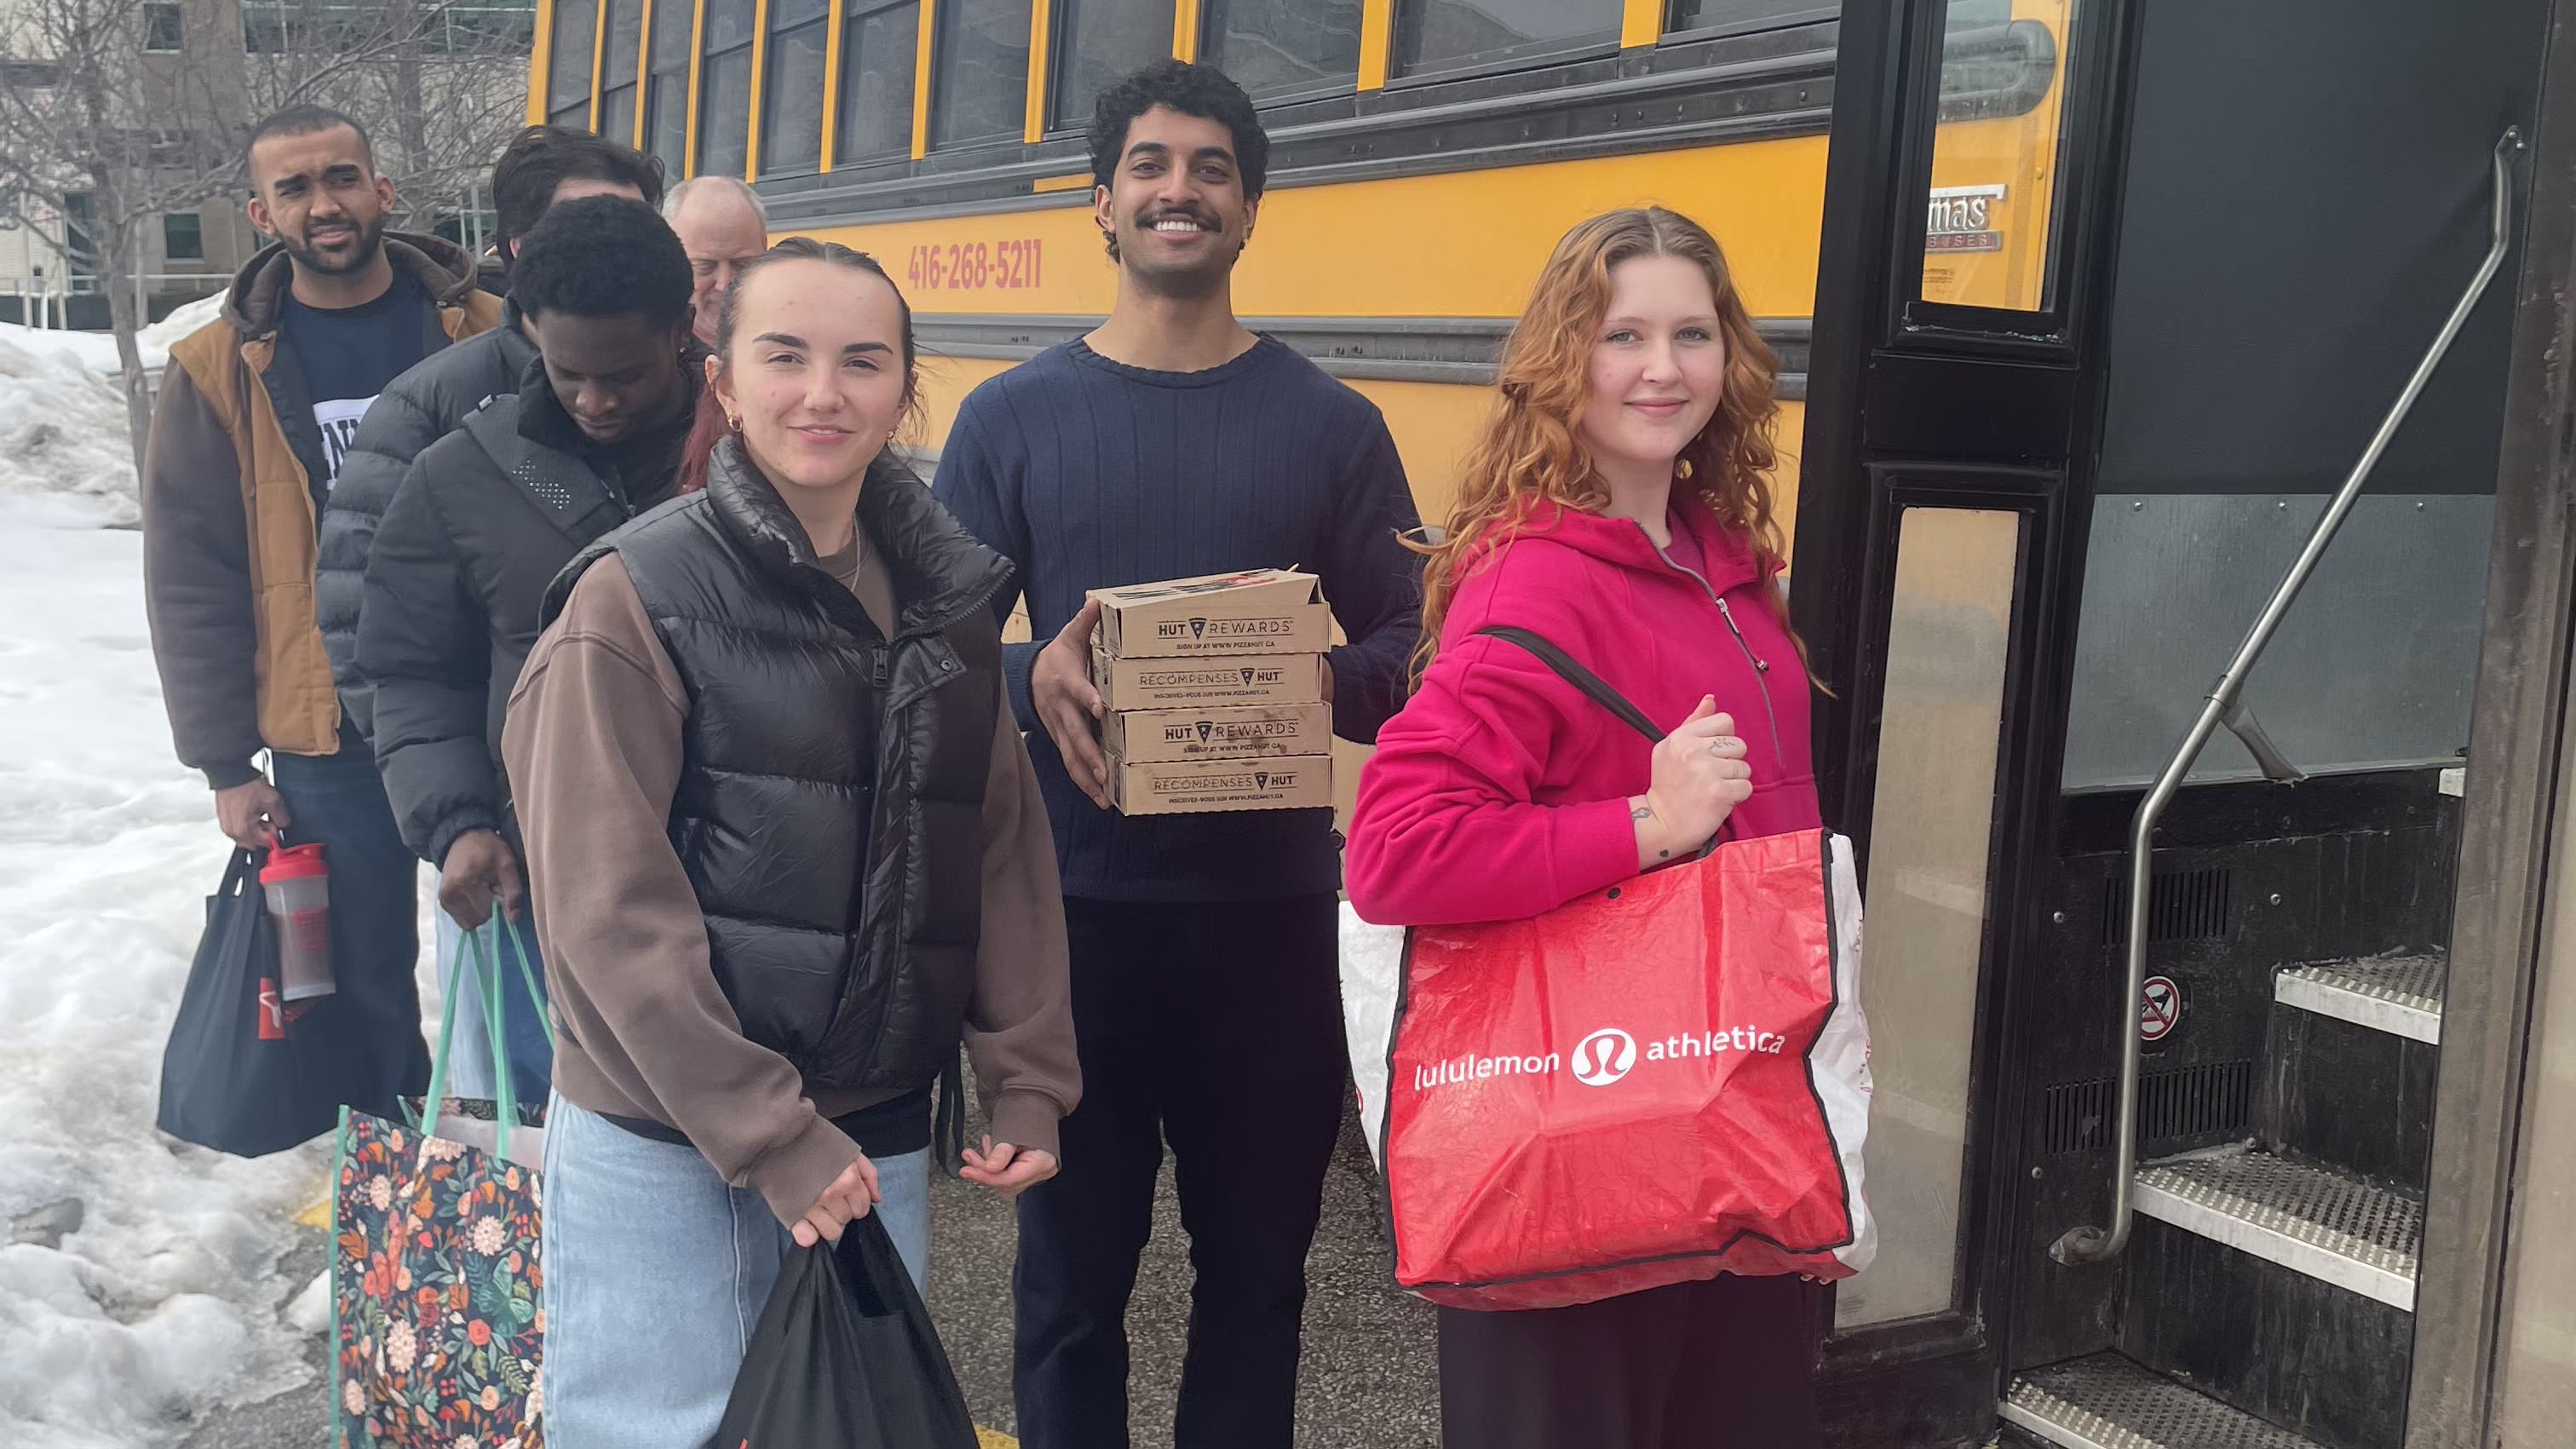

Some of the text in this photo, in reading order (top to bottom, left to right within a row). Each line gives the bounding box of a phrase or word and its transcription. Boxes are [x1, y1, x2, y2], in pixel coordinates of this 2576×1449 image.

[908, 239, 1042, 290] 416-268-5211
[1158, 619, 1293, 636] HUT REWARDS
[1256, 671, 1280, 681] HUT
[1164, 722, 1296, 740] HUT REWARDS
[1270, 775, 1294, 786] HUT
[1414, 1024, 1785, 1090] lululemon athletica
